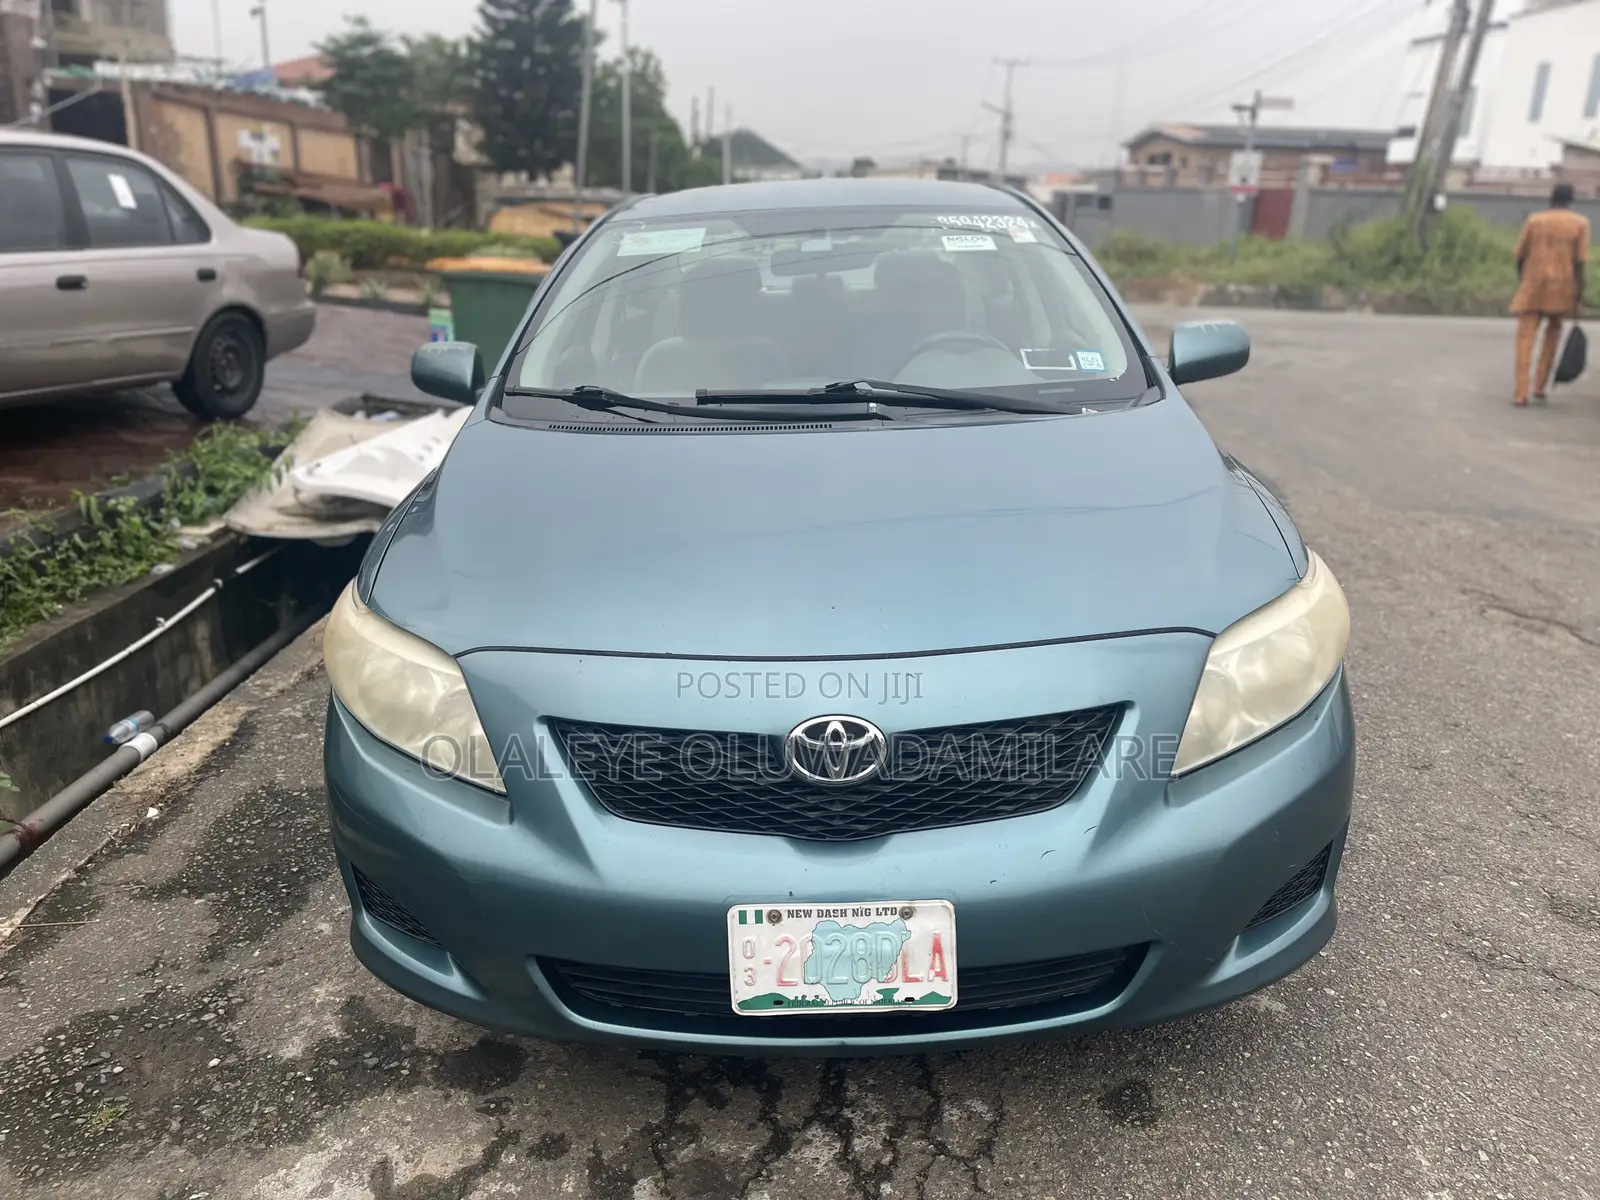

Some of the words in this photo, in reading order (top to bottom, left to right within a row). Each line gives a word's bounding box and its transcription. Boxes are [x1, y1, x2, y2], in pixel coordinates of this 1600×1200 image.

[787, 908, 813, 919] NEW
[816, 908, 848, 918] DASH
[851, 907, 872, 917] NIG
[875, 906, 898, 917] LTD
